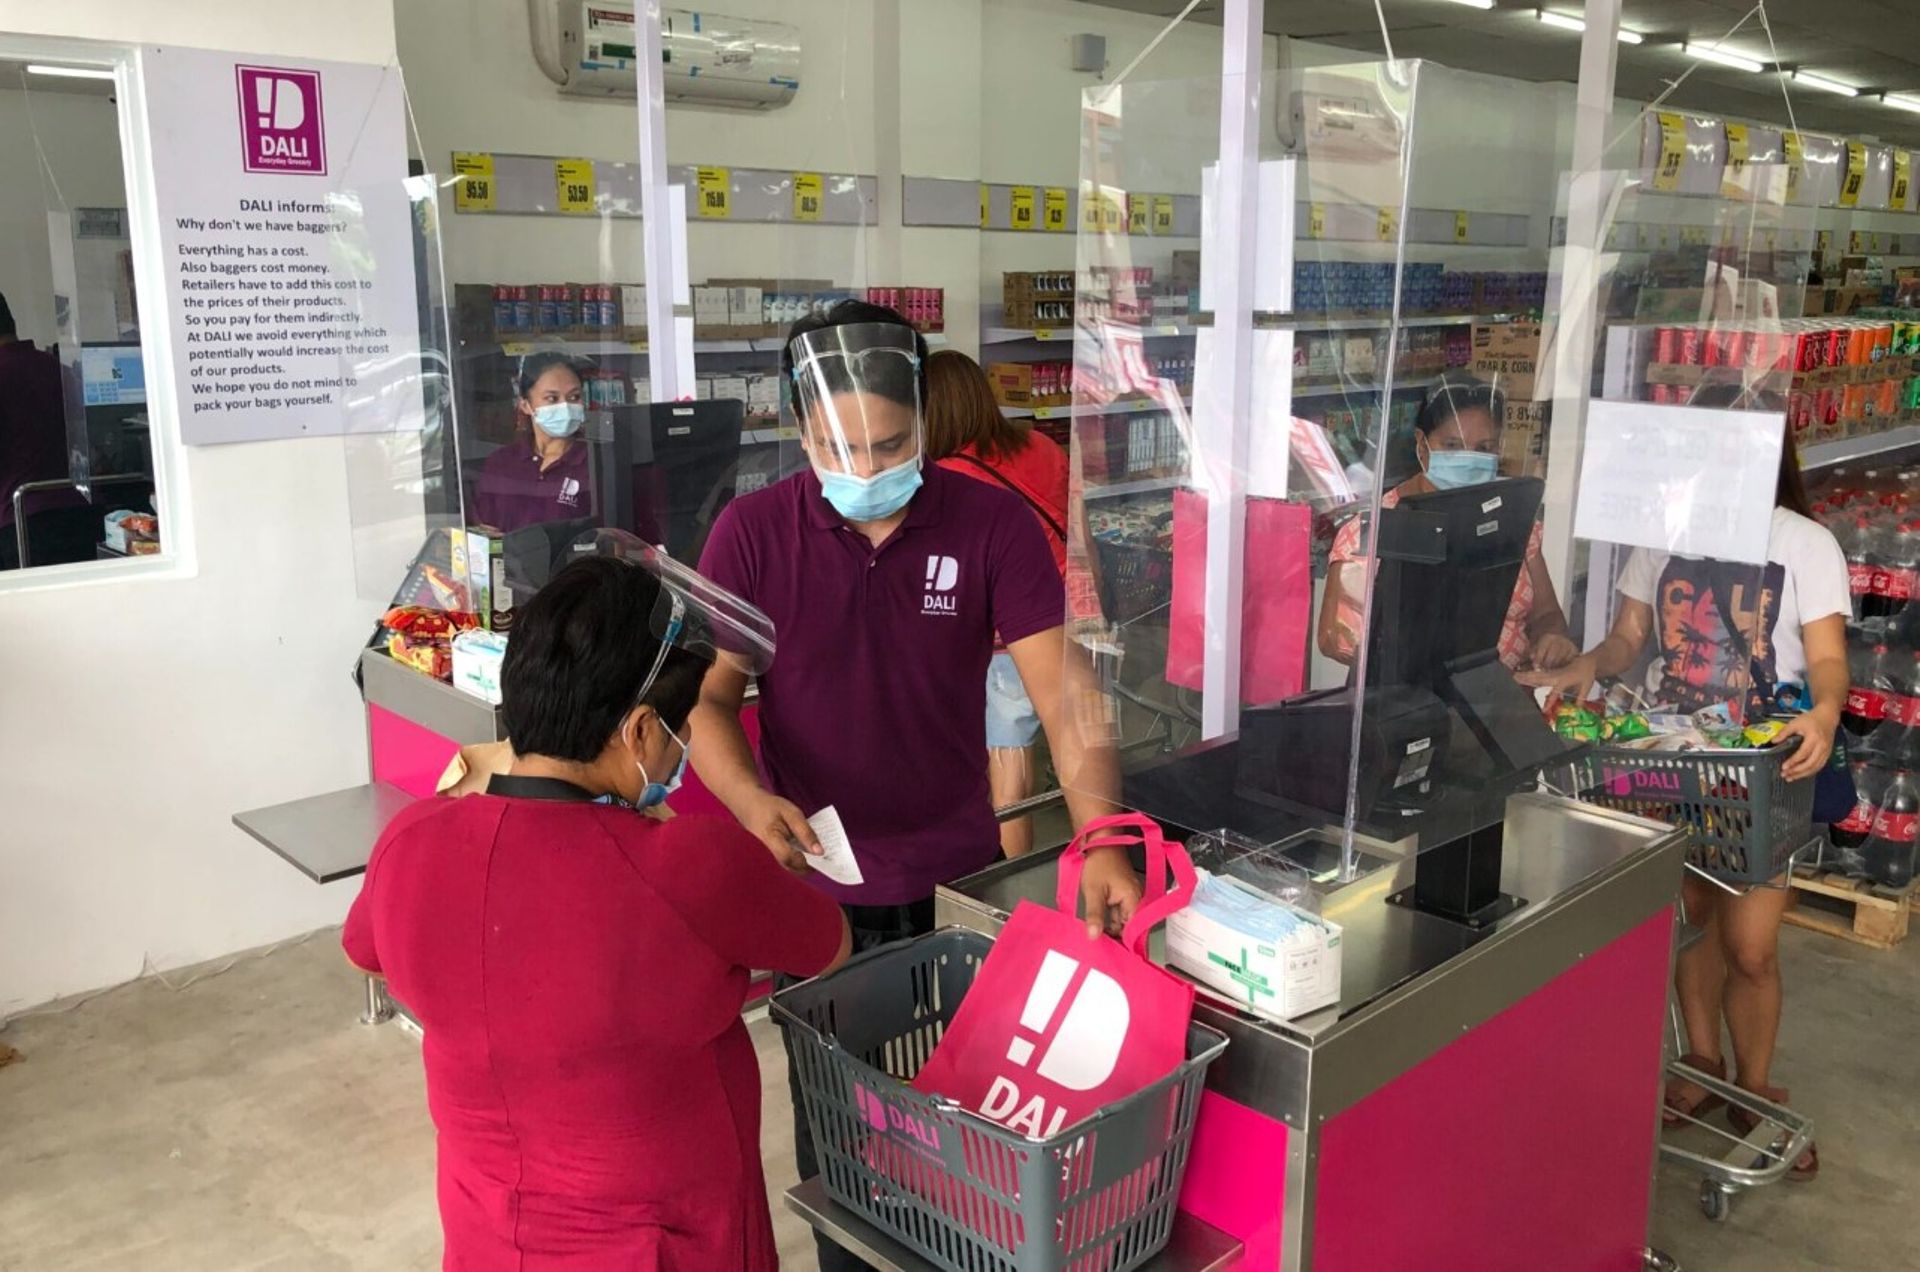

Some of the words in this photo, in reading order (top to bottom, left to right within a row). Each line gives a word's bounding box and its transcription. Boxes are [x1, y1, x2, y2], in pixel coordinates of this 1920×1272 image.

[260, 135, 308, 157] DALI
[240, 199, 273, 212] DALI
[176, 218, 205, 232] Why
[208, 219, 241, 230] don't
[244, 222, 262, 231] we
[265, 220, 294, 231] have
[297, 220, 347, 234] baggers?
[178, 244, 245, 258] Everything
[247, 245, 268, 256] has
[271, 248, 278, 256] a
[281, 246, 308, 256] cost.
[180, 261, 207, 273] Also
[210, 261, 258, 275] baggers
[261, 263, 285, 273] cost
[288, 264, 330, 275] money.
[182, 279, 236, 290] Retailers
[238, 279, 267, 290] have
[270, 280, 283, 290] to
[286, 279, 308, 289] add
[311, 279, 332, 290] this
[334, 280, 357, 289] cost
[360, 280, 372, 289] to
[183, 296, 204, 308] the
[207, 296, 244, 309] prices
[247, 296, 259, 307] of
[262, 296, 290, 307] their
[294, 296, 347, 308] products.
[185, 314, 201, 325] So
[204, 315, 227, 327] you
[229, 315, 251, 326] pay
[254, 313, 271, 324] for
[274, 312, 305, 323] them
[308, 312, 363, 323] indirectly.
[187, 331, 201, 342] At
[204, 331, 232, 341] DALI
[234, 333, 253, 341] we
[256, 330, 288, 341] avoid
[291, 328, 351, 341] everything
[353, 328, 387, 338] which
[189, 347, 254, 362] potentially
[257, 346, 293, 357] would
[296, 345, 342, 356] increase
[346, 344, 364, 354] the
[367, 344, 390, 354] cost
[190, 366, 203, 377] of
[206, 367, 227, 377] our
[230, 364, 286, 378] products.
[192, 383, 213, 394] We
[215, 382, 246, 394] hope
[248, 382, 270, 394] you
[273, 379, 289, 390] do
[291, 379, 311, 389] not
[314, 377, 343, 388] mind
[346, 378, 357, 387] to
[193, 399, 222, 414] pack
[225, 399, 252, 411] your
[255, 396, 282, 409] bags
[284, 393, 333, 408] yourself.
[924, 595, 956, 611] DALI
[1634, 769, 1680, 790] DALI
[887, 1103, 941, 1151] DALI
